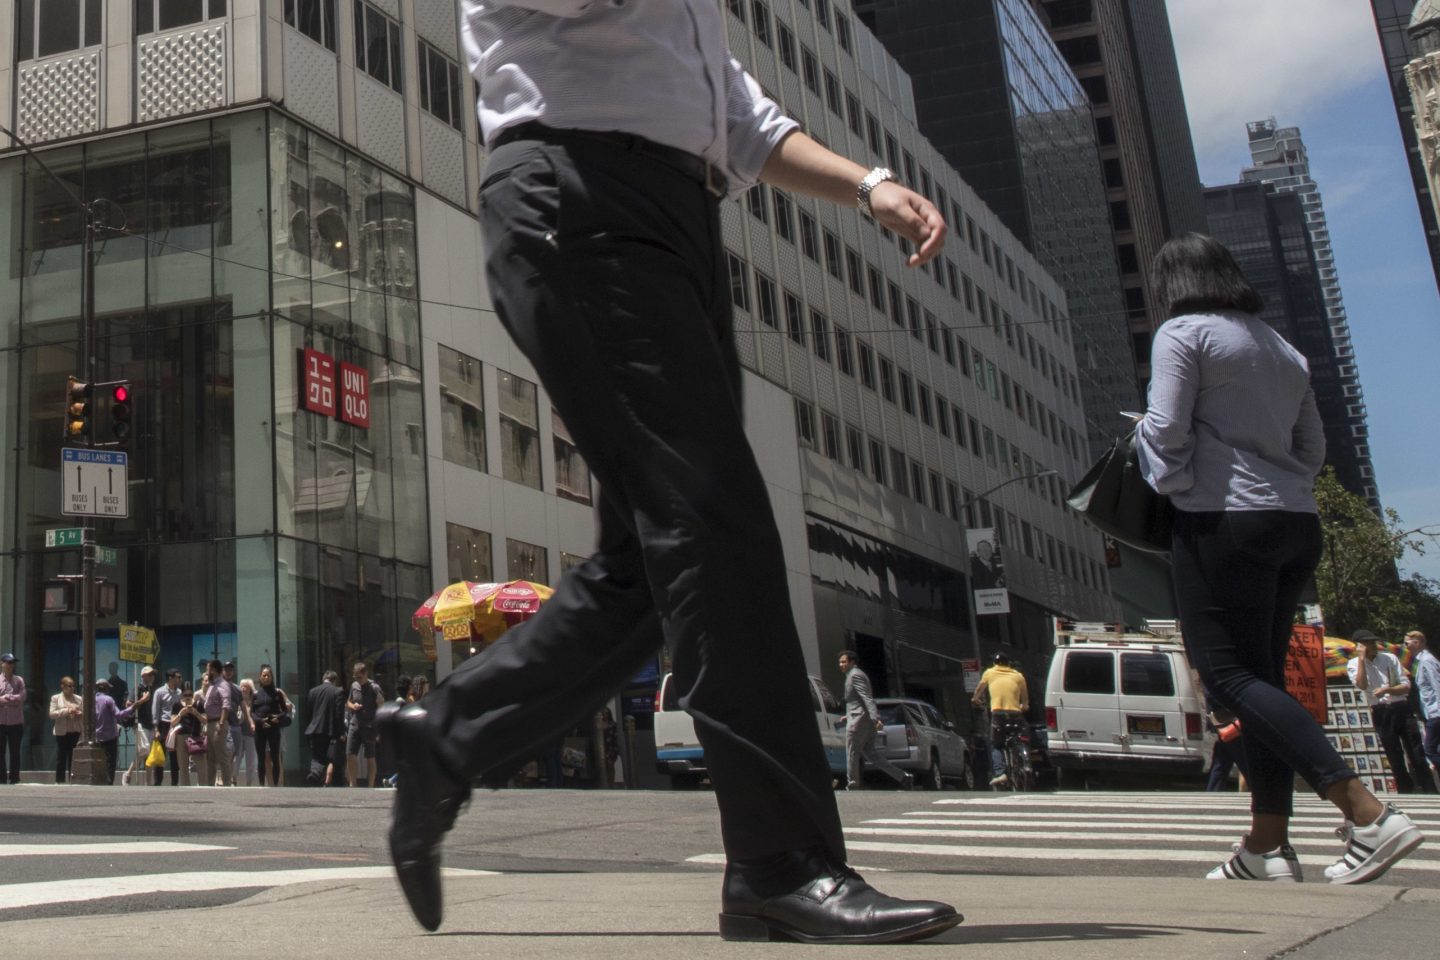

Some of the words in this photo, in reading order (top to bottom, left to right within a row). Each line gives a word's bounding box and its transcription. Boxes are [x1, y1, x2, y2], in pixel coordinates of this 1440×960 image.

[310, 355, 331, 383] ユニ
[344, 368, 365, 395] UNI
[309, 382, 333, 409] クロ
[345, 394, 367, 419] QLO
[78, 451, 91, 461] BUS
[91, 452, 112, 463] LANES
[71, 494, 88, 503] BUSES
[72, 503, 86, 512] ONLY
[104, 505, 118, 513] ONLY
[59, 531, 65, 545] 5
[1297, 676, 1317, 689] AVE
